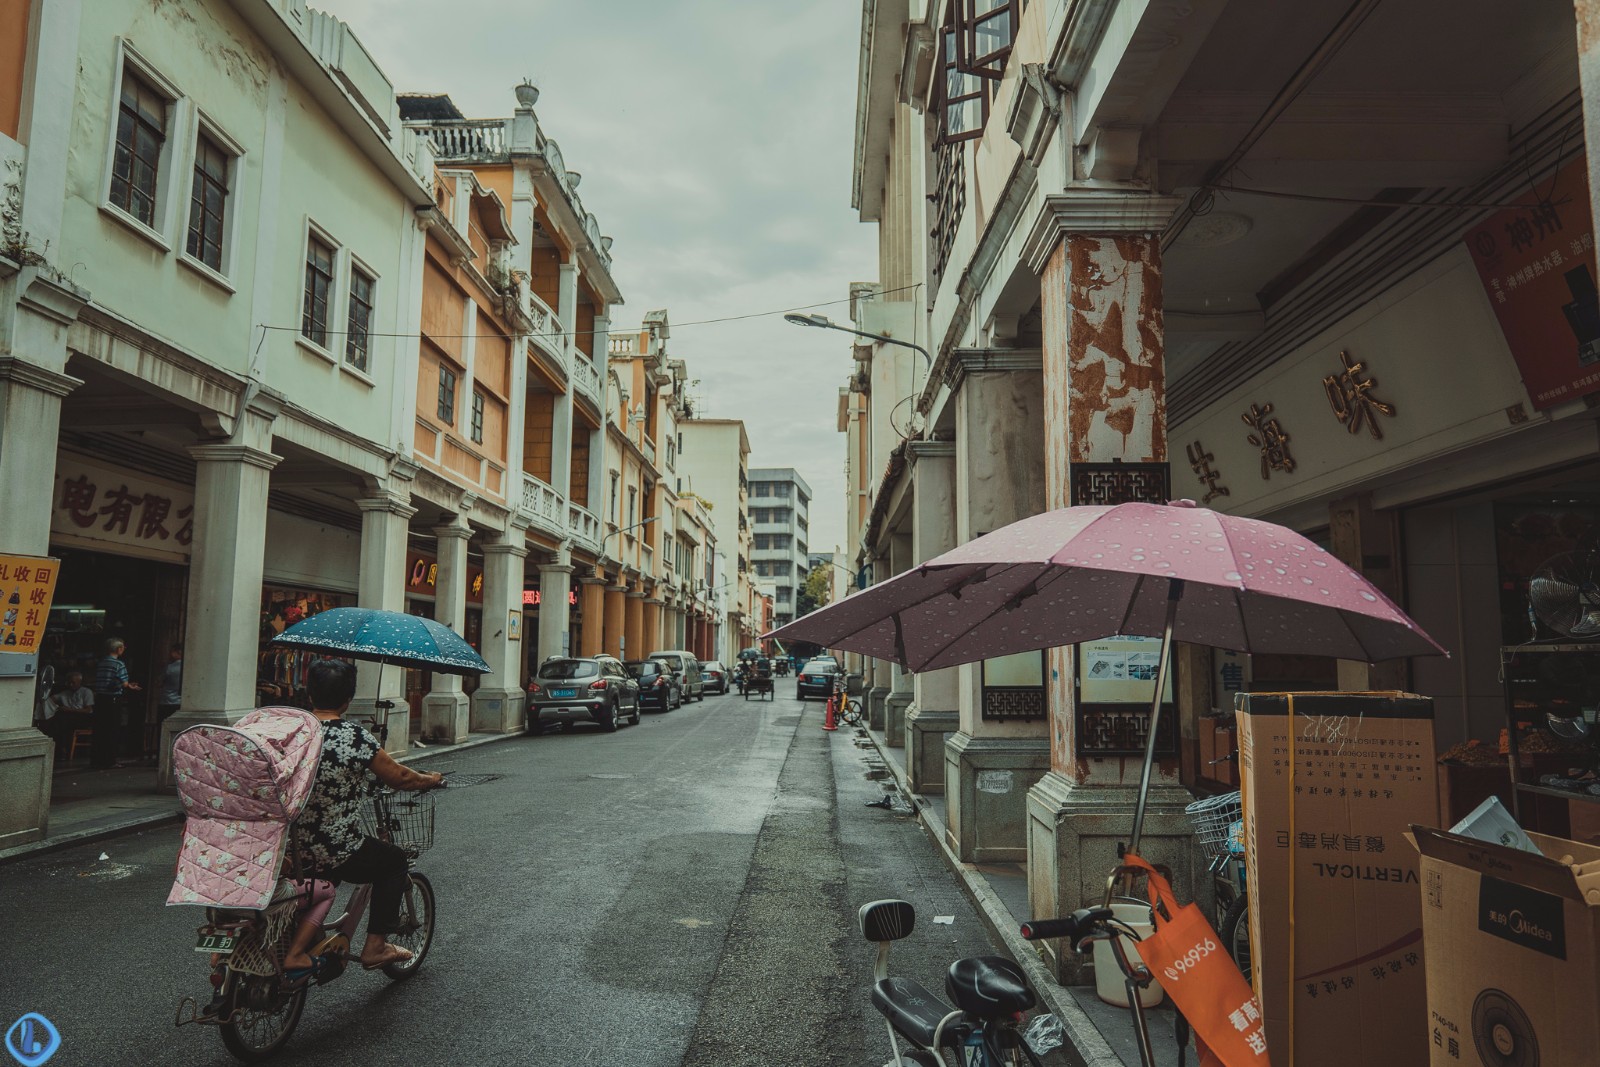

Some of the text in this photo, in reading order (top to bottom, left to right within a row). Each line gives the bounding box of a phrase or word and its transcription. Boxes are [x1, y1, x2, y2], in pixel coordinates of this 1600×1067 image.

[1312, 862, 1419, 884] VERTICAL
[1489, 909, 1553, 942] 美的 Midea
[1174, 937, 1217, 974] 96956
[1228, 997, 1260, 1032] 看高
[1433, 1027, 1460, 1060] 台扇
